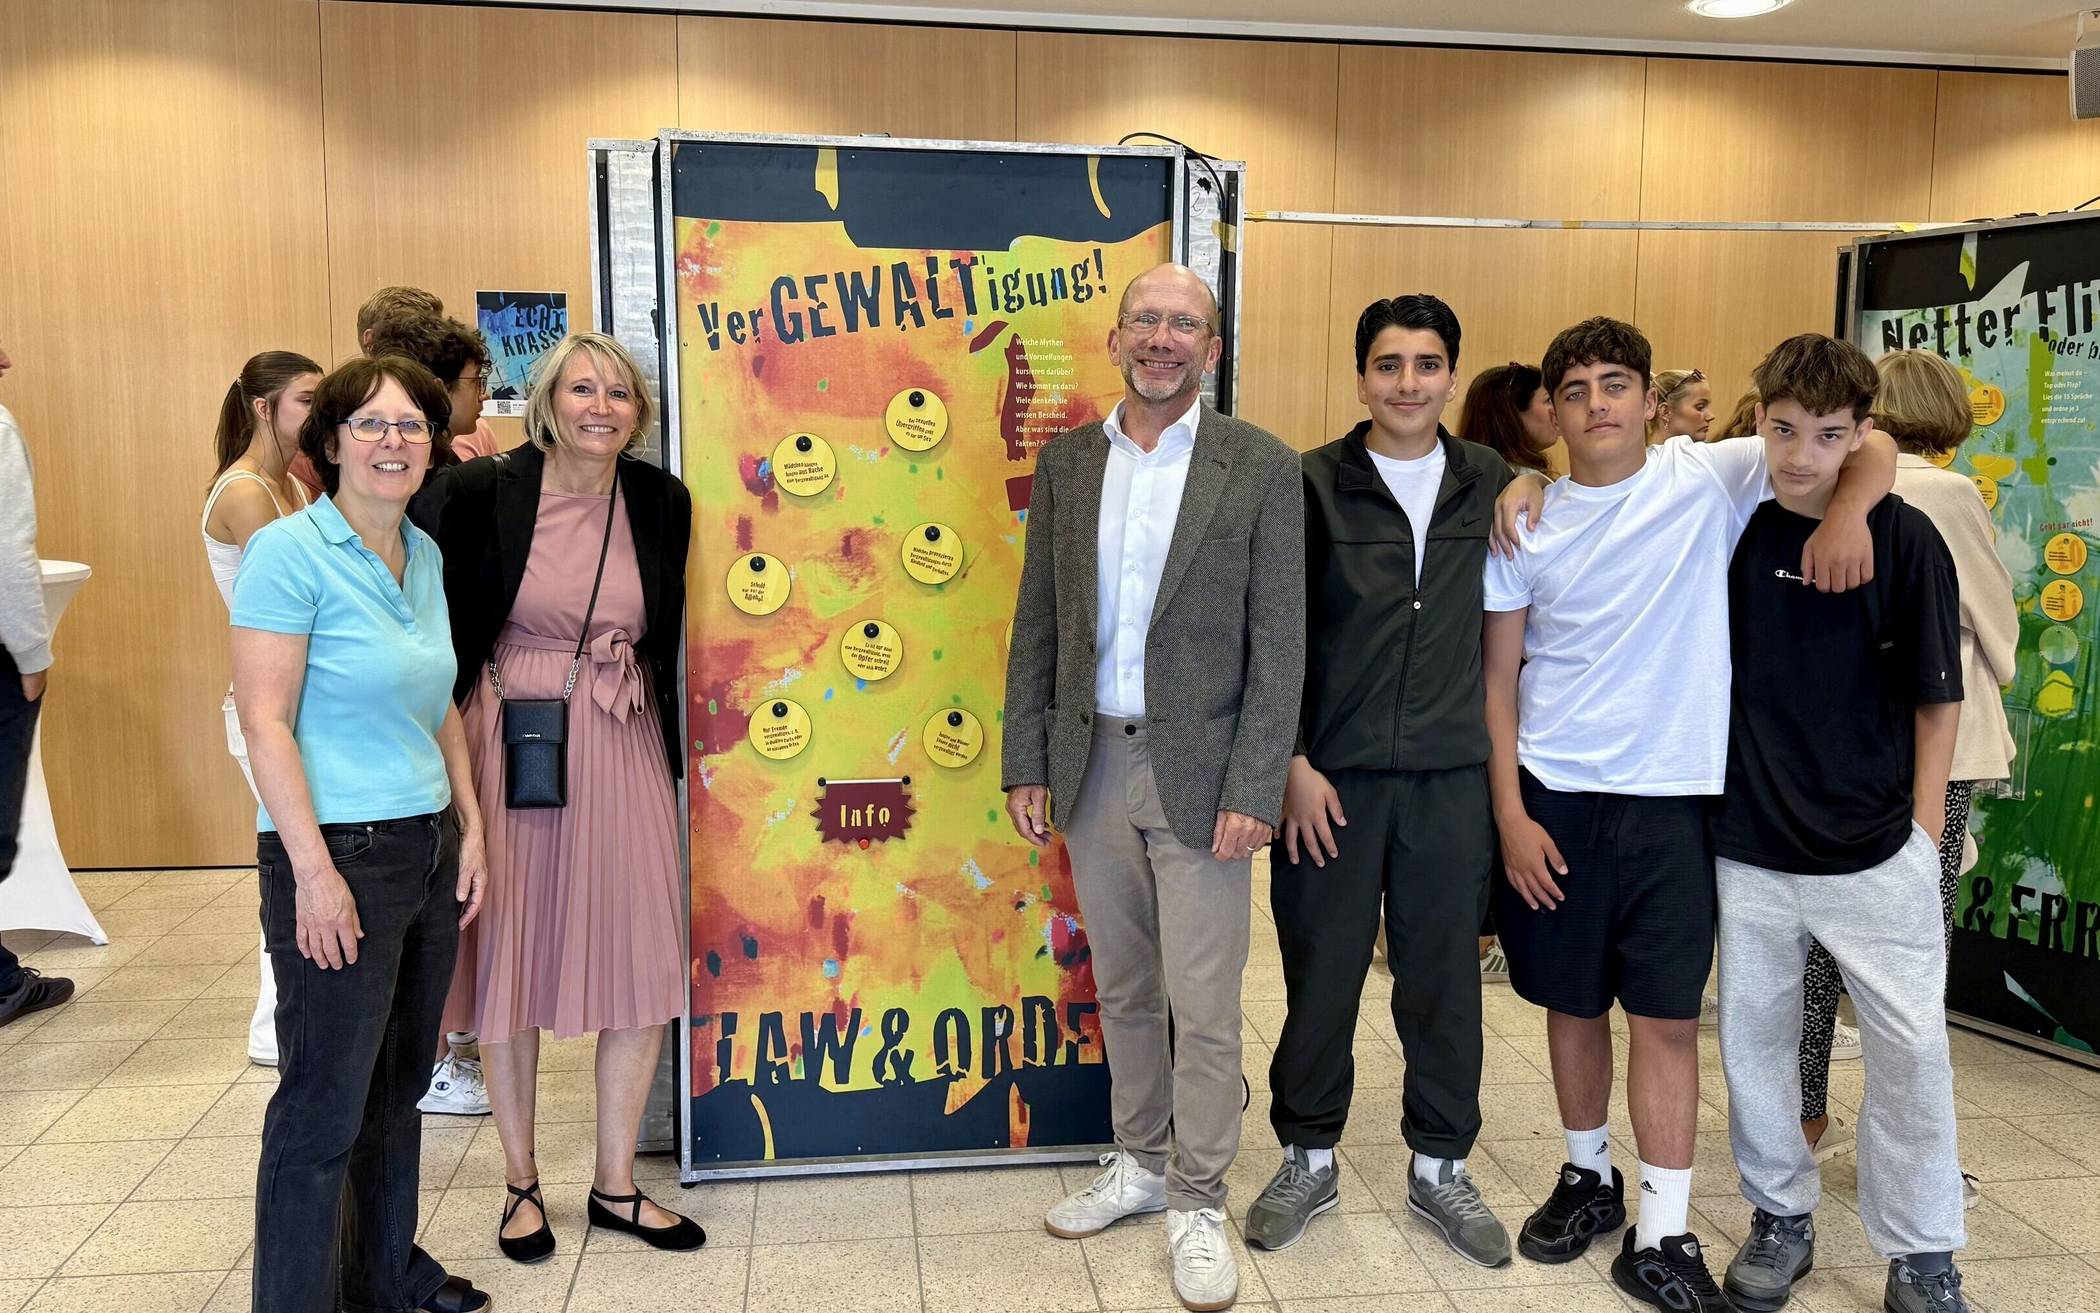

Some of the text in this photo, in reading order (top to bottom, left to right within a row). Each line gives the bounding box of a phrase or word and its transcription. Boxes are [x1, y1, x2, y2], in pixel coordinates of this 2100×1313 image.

[697, 248, 1107, 351] VerGEWALTigung!
[515, 305, 564, 332] ECHT
[1882, 281, 2100, 360] Netter Fli
[1015, 337, 1064, 348] Welche Mythen
[2048, 337, 2084, 357] oder
[1015, 352, 1073, 362] und Vorstellungen
[1015, 367, 1074, 376] kursieren darüber?
[1015, 381, 1028, 390] Wie
[1029, 381, 1051, 390] kommt
[1060, 381, 1079, 391] dazu?
[2043, 382, 2054, 390] Top
[1015, 396, 1068, 406] Viele denken, sie
[2042, 393, 2054, 401] Lies
[1015, 411, 1068, 419] wissen Bescheid.
[1015, 425, 1030, 433] Aber
[1044, 425, 1058, 433] sind
[1058, 425, 1069, 433] die
[1015, 439, 1040, 447] Fakten?
[2040, 522, 2056, 532] Geht
[2072, 518, 2093, 529] nicht!
[840, 803, 891, 828] Info
[1963, 875, 1996, 934] &
[716, 996, 1108, 1086] LAW & ORDE
